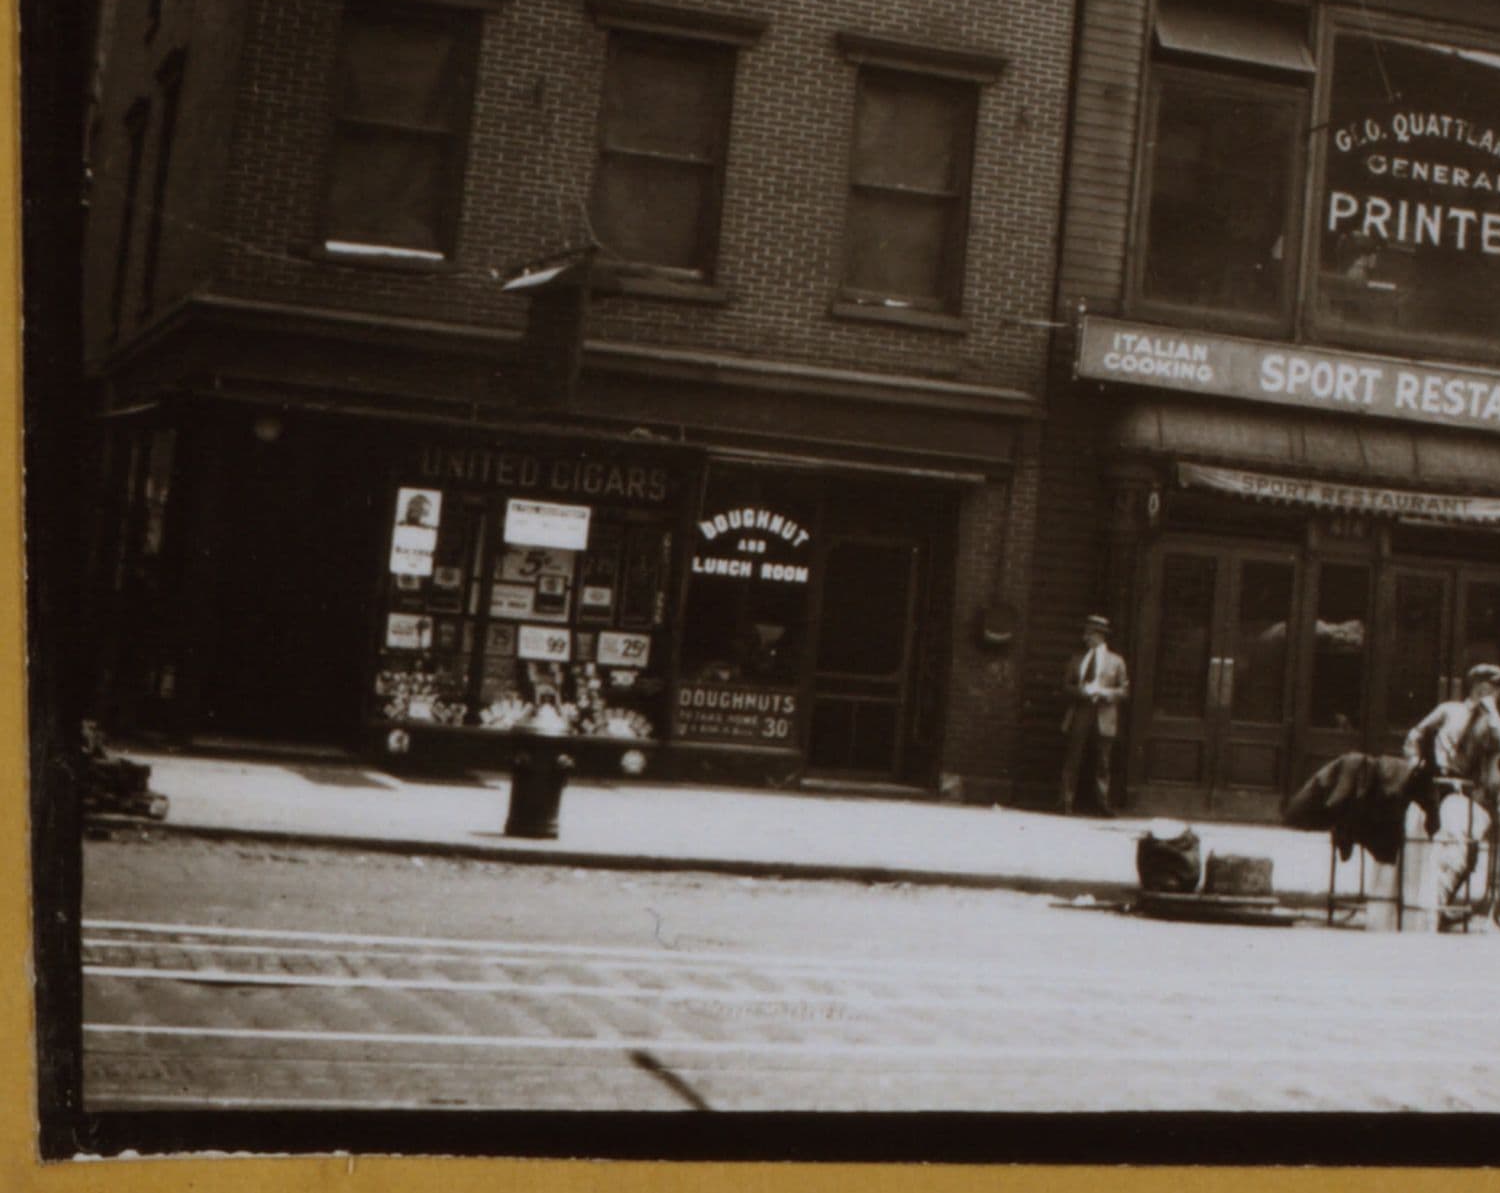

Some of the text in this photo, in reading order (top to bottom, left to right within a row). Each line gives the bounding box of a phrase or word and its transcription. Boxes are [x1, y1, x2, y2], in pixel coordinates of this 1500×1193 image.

[1112, 332, 1208, 362] ITALIAN
[1103, 352, 1214, 383] COOKING
[1260, 353, 1383, 405] SPORT
[420, 447, 668, 503] UNITED CIGARS
[1239, 475, 1472, 515] SPORT RESTAURANT
[699, 507, 811, 548] DOUGHNUT
[691, 555, 809, 583] LUNCH ROOM
[679, 688, 796, 715] DOUGHNUTS
